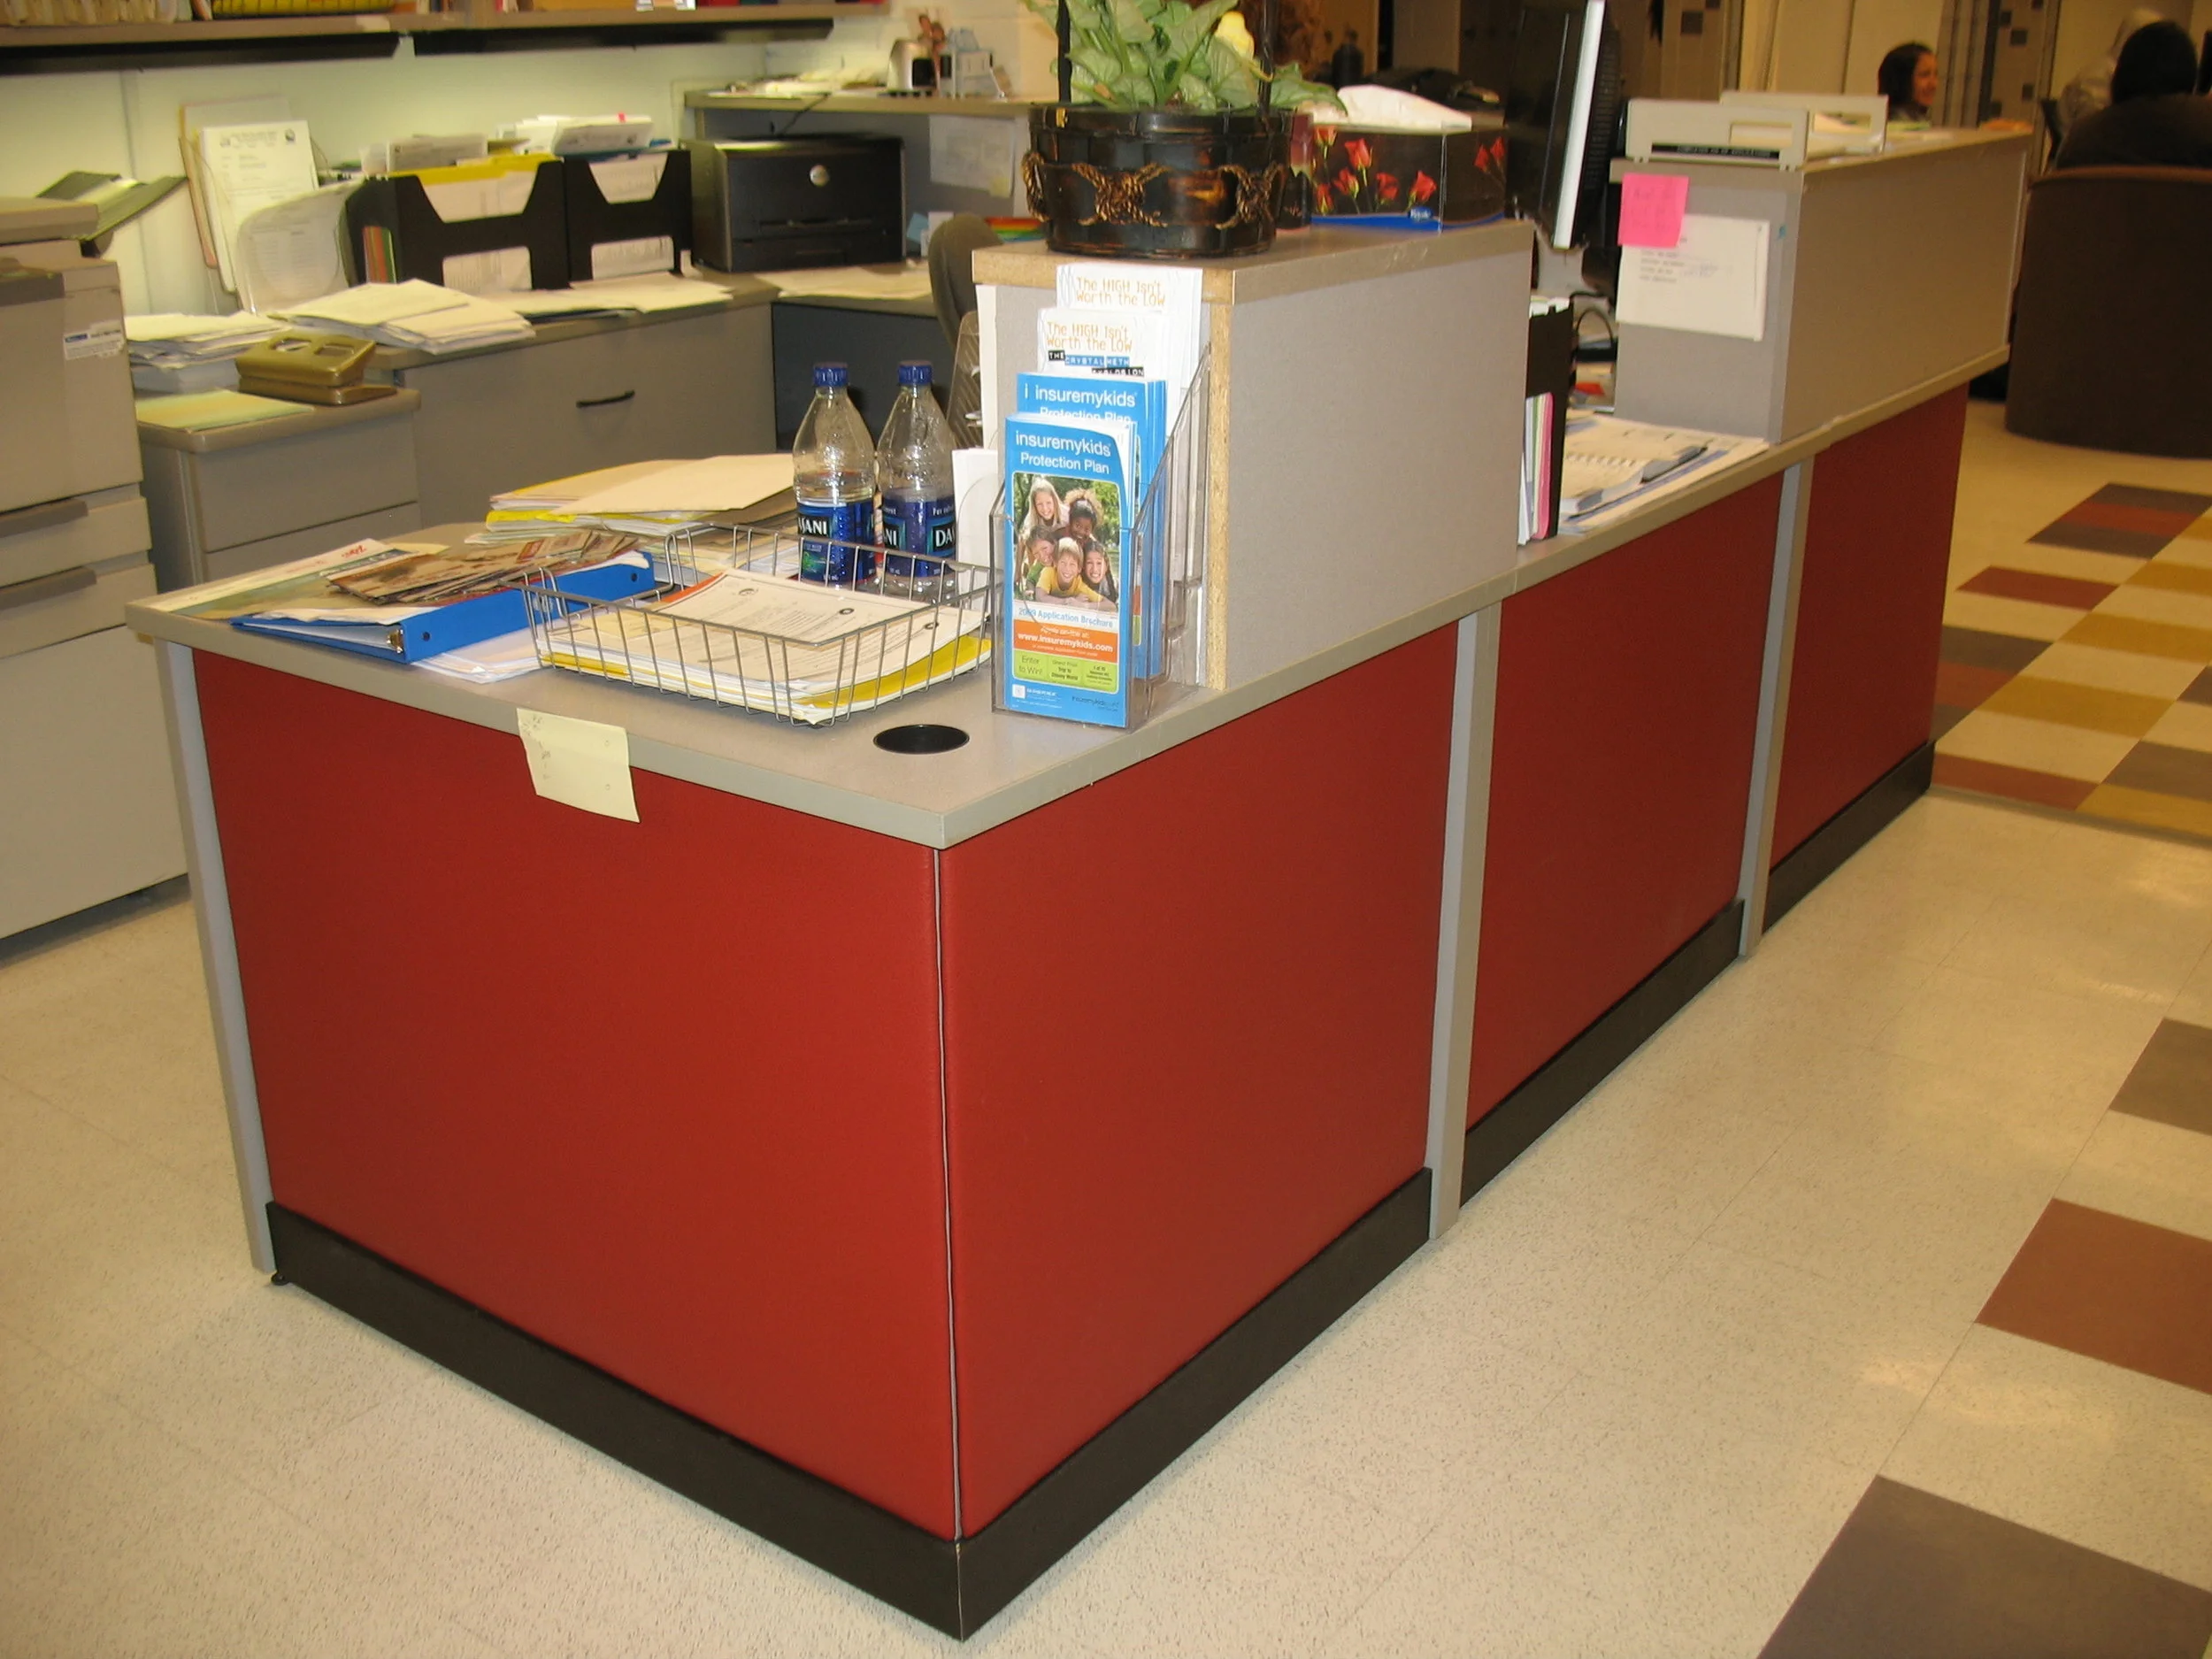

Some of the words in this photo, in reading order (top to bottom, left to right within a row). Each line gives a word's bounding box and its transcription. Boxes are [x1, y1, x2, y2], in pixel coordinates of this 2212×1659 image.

[1076, 276, 1097, 291] The
[1102, 278, 1131, 292] HIGH
[1118, 293, 1138, 306] the
[1046, 321, 1067, 336] The
[1071, 323, 1099, 337] HIGH
[1086, 337, 1107, 351] the
[1048, 351, 1064, 360] THE
[1065, 356, 1104, 366] CRYSTAL
[1034, 384, 1136, 409] insuremykids
[1015, 430, 1111, 457] insuremykids
[1020, 451, 1081, 471] Protection
[1084, 458, 1110, 475] Plan
[1038, 609, 1079, 623] Application
[1081, 615, 1114, 628] Brochure
[1018, 633, 1114, 653] www.insuremykids.com
[1021, 655, 1040, 665] Enter
